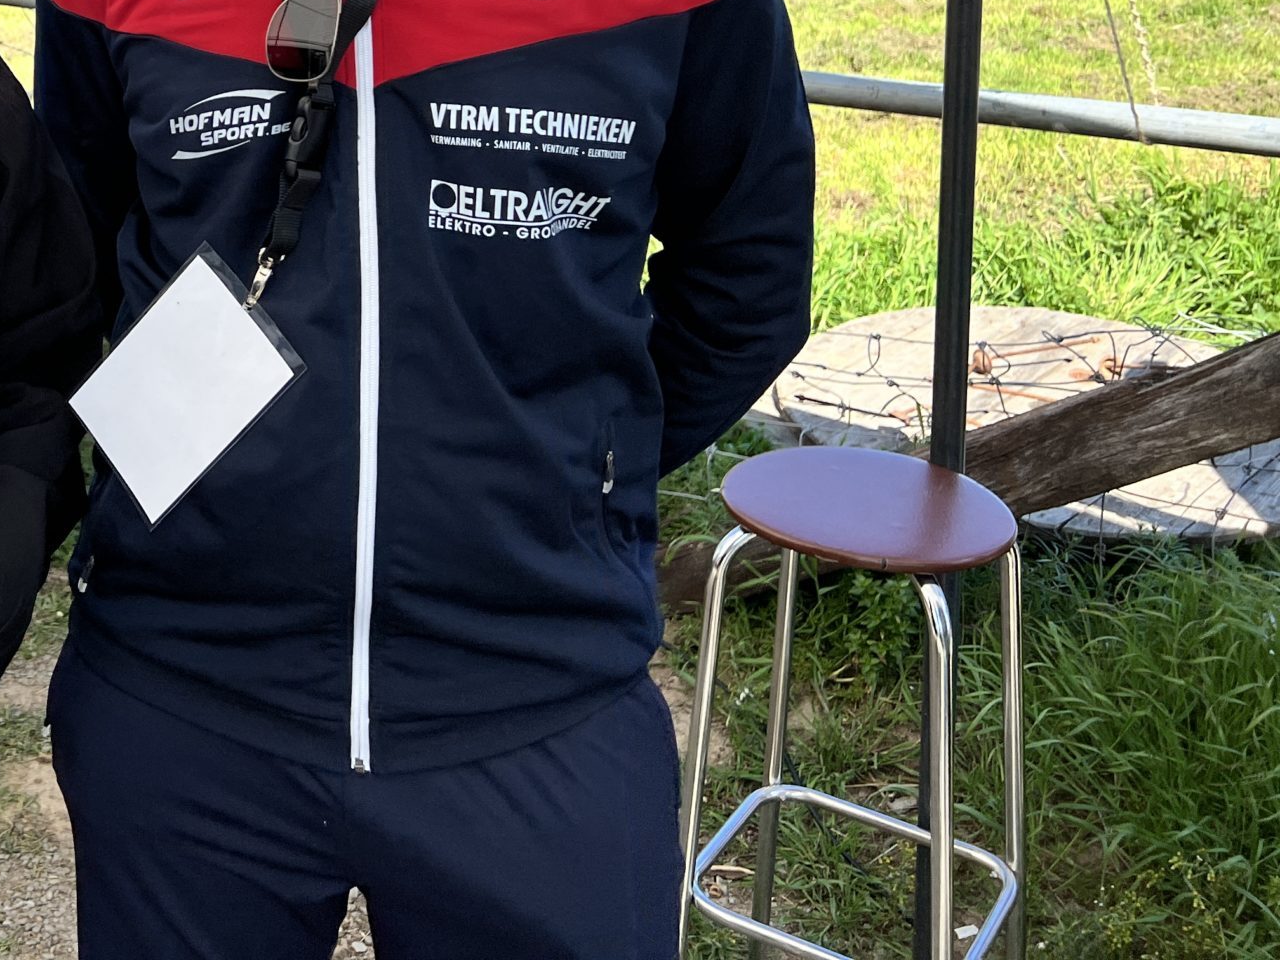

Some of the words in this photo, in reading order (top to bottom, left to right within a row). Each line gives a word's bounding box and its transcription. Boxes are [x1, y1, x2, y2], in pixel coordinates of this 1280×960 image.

[169, 102, 272, 135] HOFMAN
[429, 102, 500, 133] VTRM
[505, 107, 636, 145] TECHNIEKEN
[200, 121, 292, 147] SPORT.BE
[430, 134, 482, 148] VERWARMING
[494, 140, 531, 151] SANITAIR
[541, 143, 579, 156] VENTILATIE
[428, 215, 496, 237] ELEKTRO
[516, 218, 593, 239] GROOANDEL
